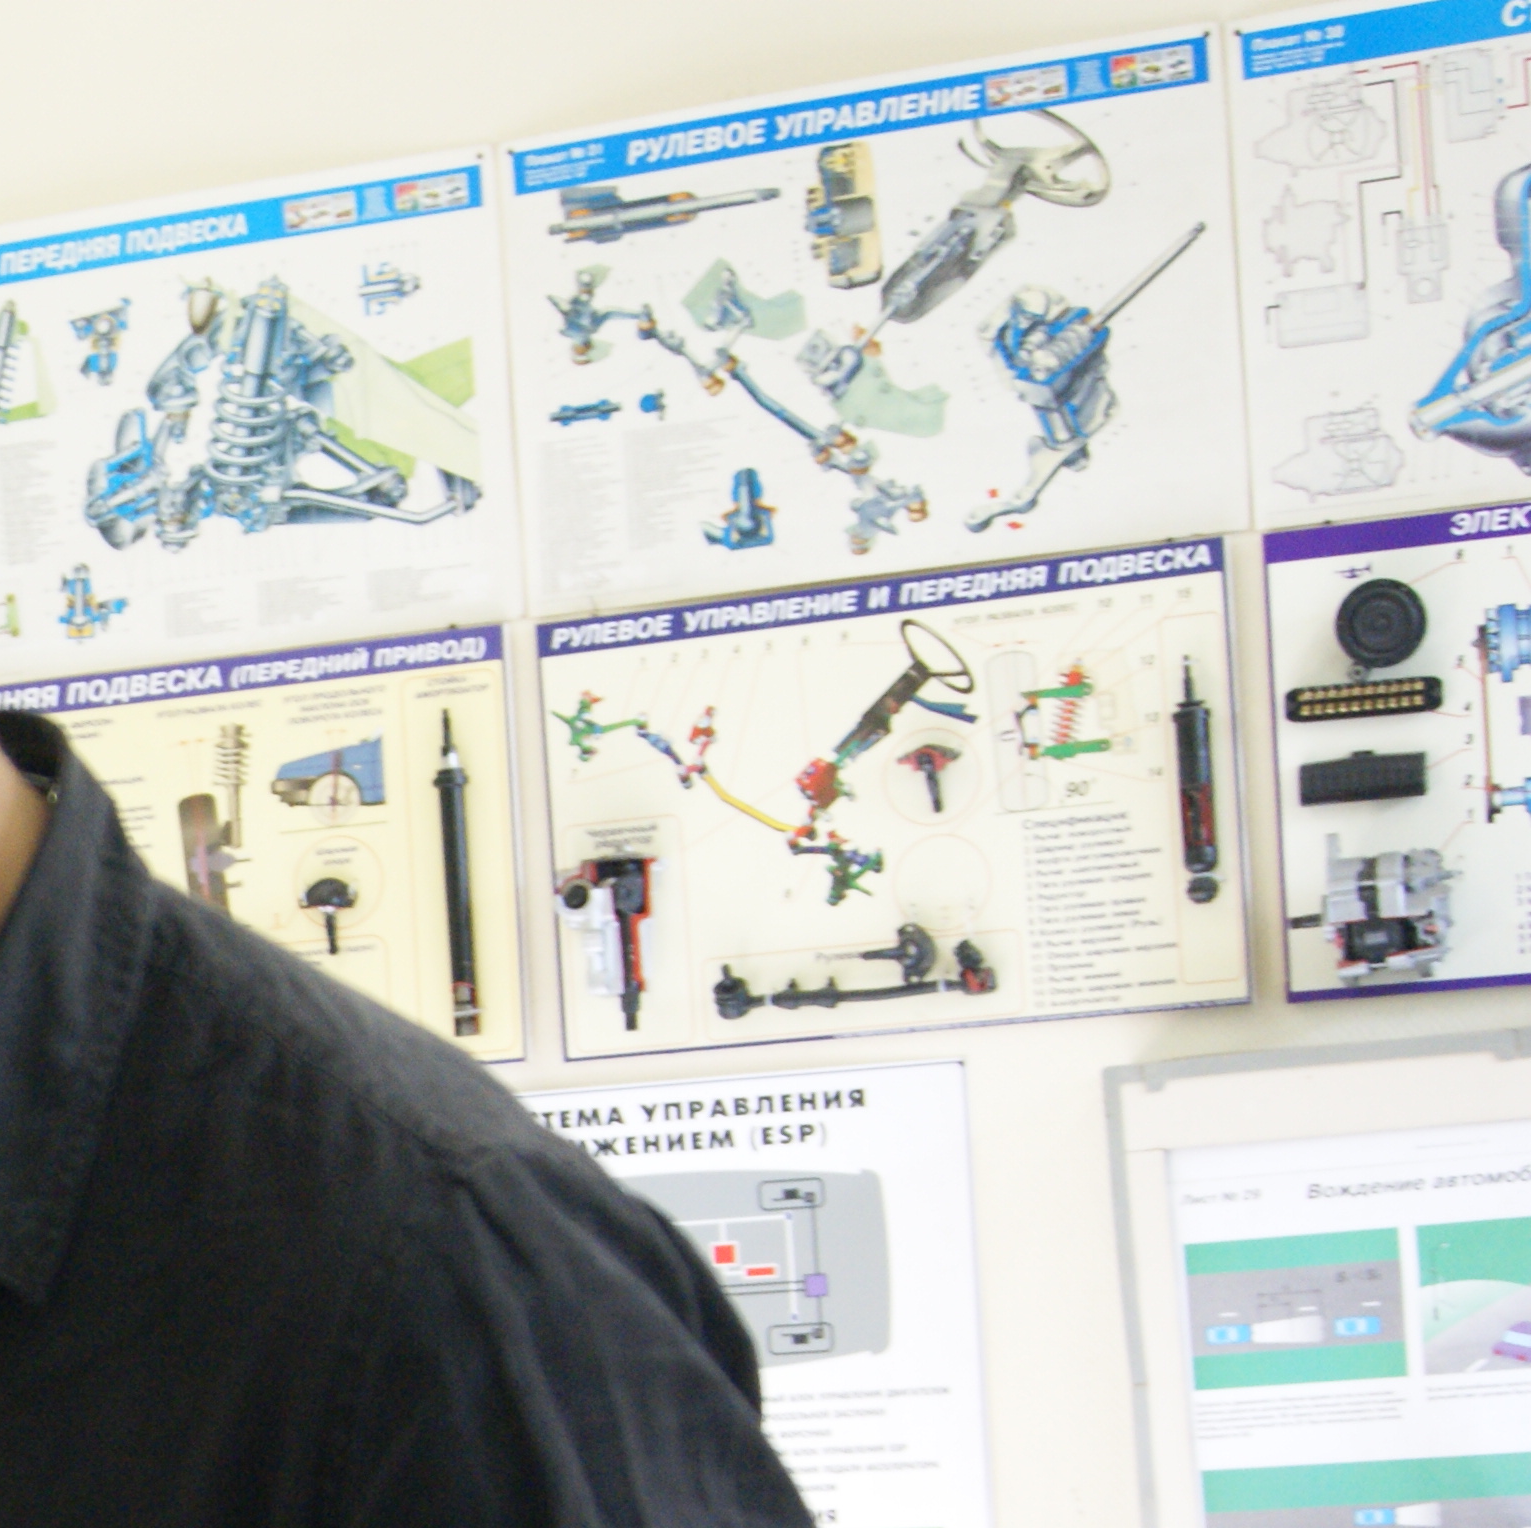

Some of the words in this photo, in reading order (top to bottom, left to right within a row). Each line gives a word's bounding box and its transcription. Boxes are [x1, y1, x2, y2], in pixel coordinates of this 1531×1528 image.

[626, 118, 767, 166] РУЛЕВОЕ
[773, 83, 981, 142] УПРАВЛЕНИЕ
[125, 212, 249, 256] ПОДВЕСКА
[550, 614, 673, 650] РУЛЕВОЕ
[682, 589, 859, 634] УПРАВЛЕНИЕ
[867, 585, 891, 609] И
[900, 561, 1047, 607] ПЕРЕДНЯЯ
[1056, 544, 1213, 586] ПОДВЕСКА
[67, 666, 222, 706] ПОДВЕСКА
[230, 650, 370, 689] (ПЕРЕДНИЙ
[375, 636, 487, 671] ПРИВОД)
[531, 1106, 625, 1130] ТЕМА
[641, 1088, 866, 1123] УПРАВЛЕНИЯ
[579, 1129, 734, 1158] ЖЕНИЕМ
[750, 1123, 828, 1151] (ESP)
[1307, 1174, 1426, 1202] Вождение
[1433, 1164, 1531, 1190] автомоб
